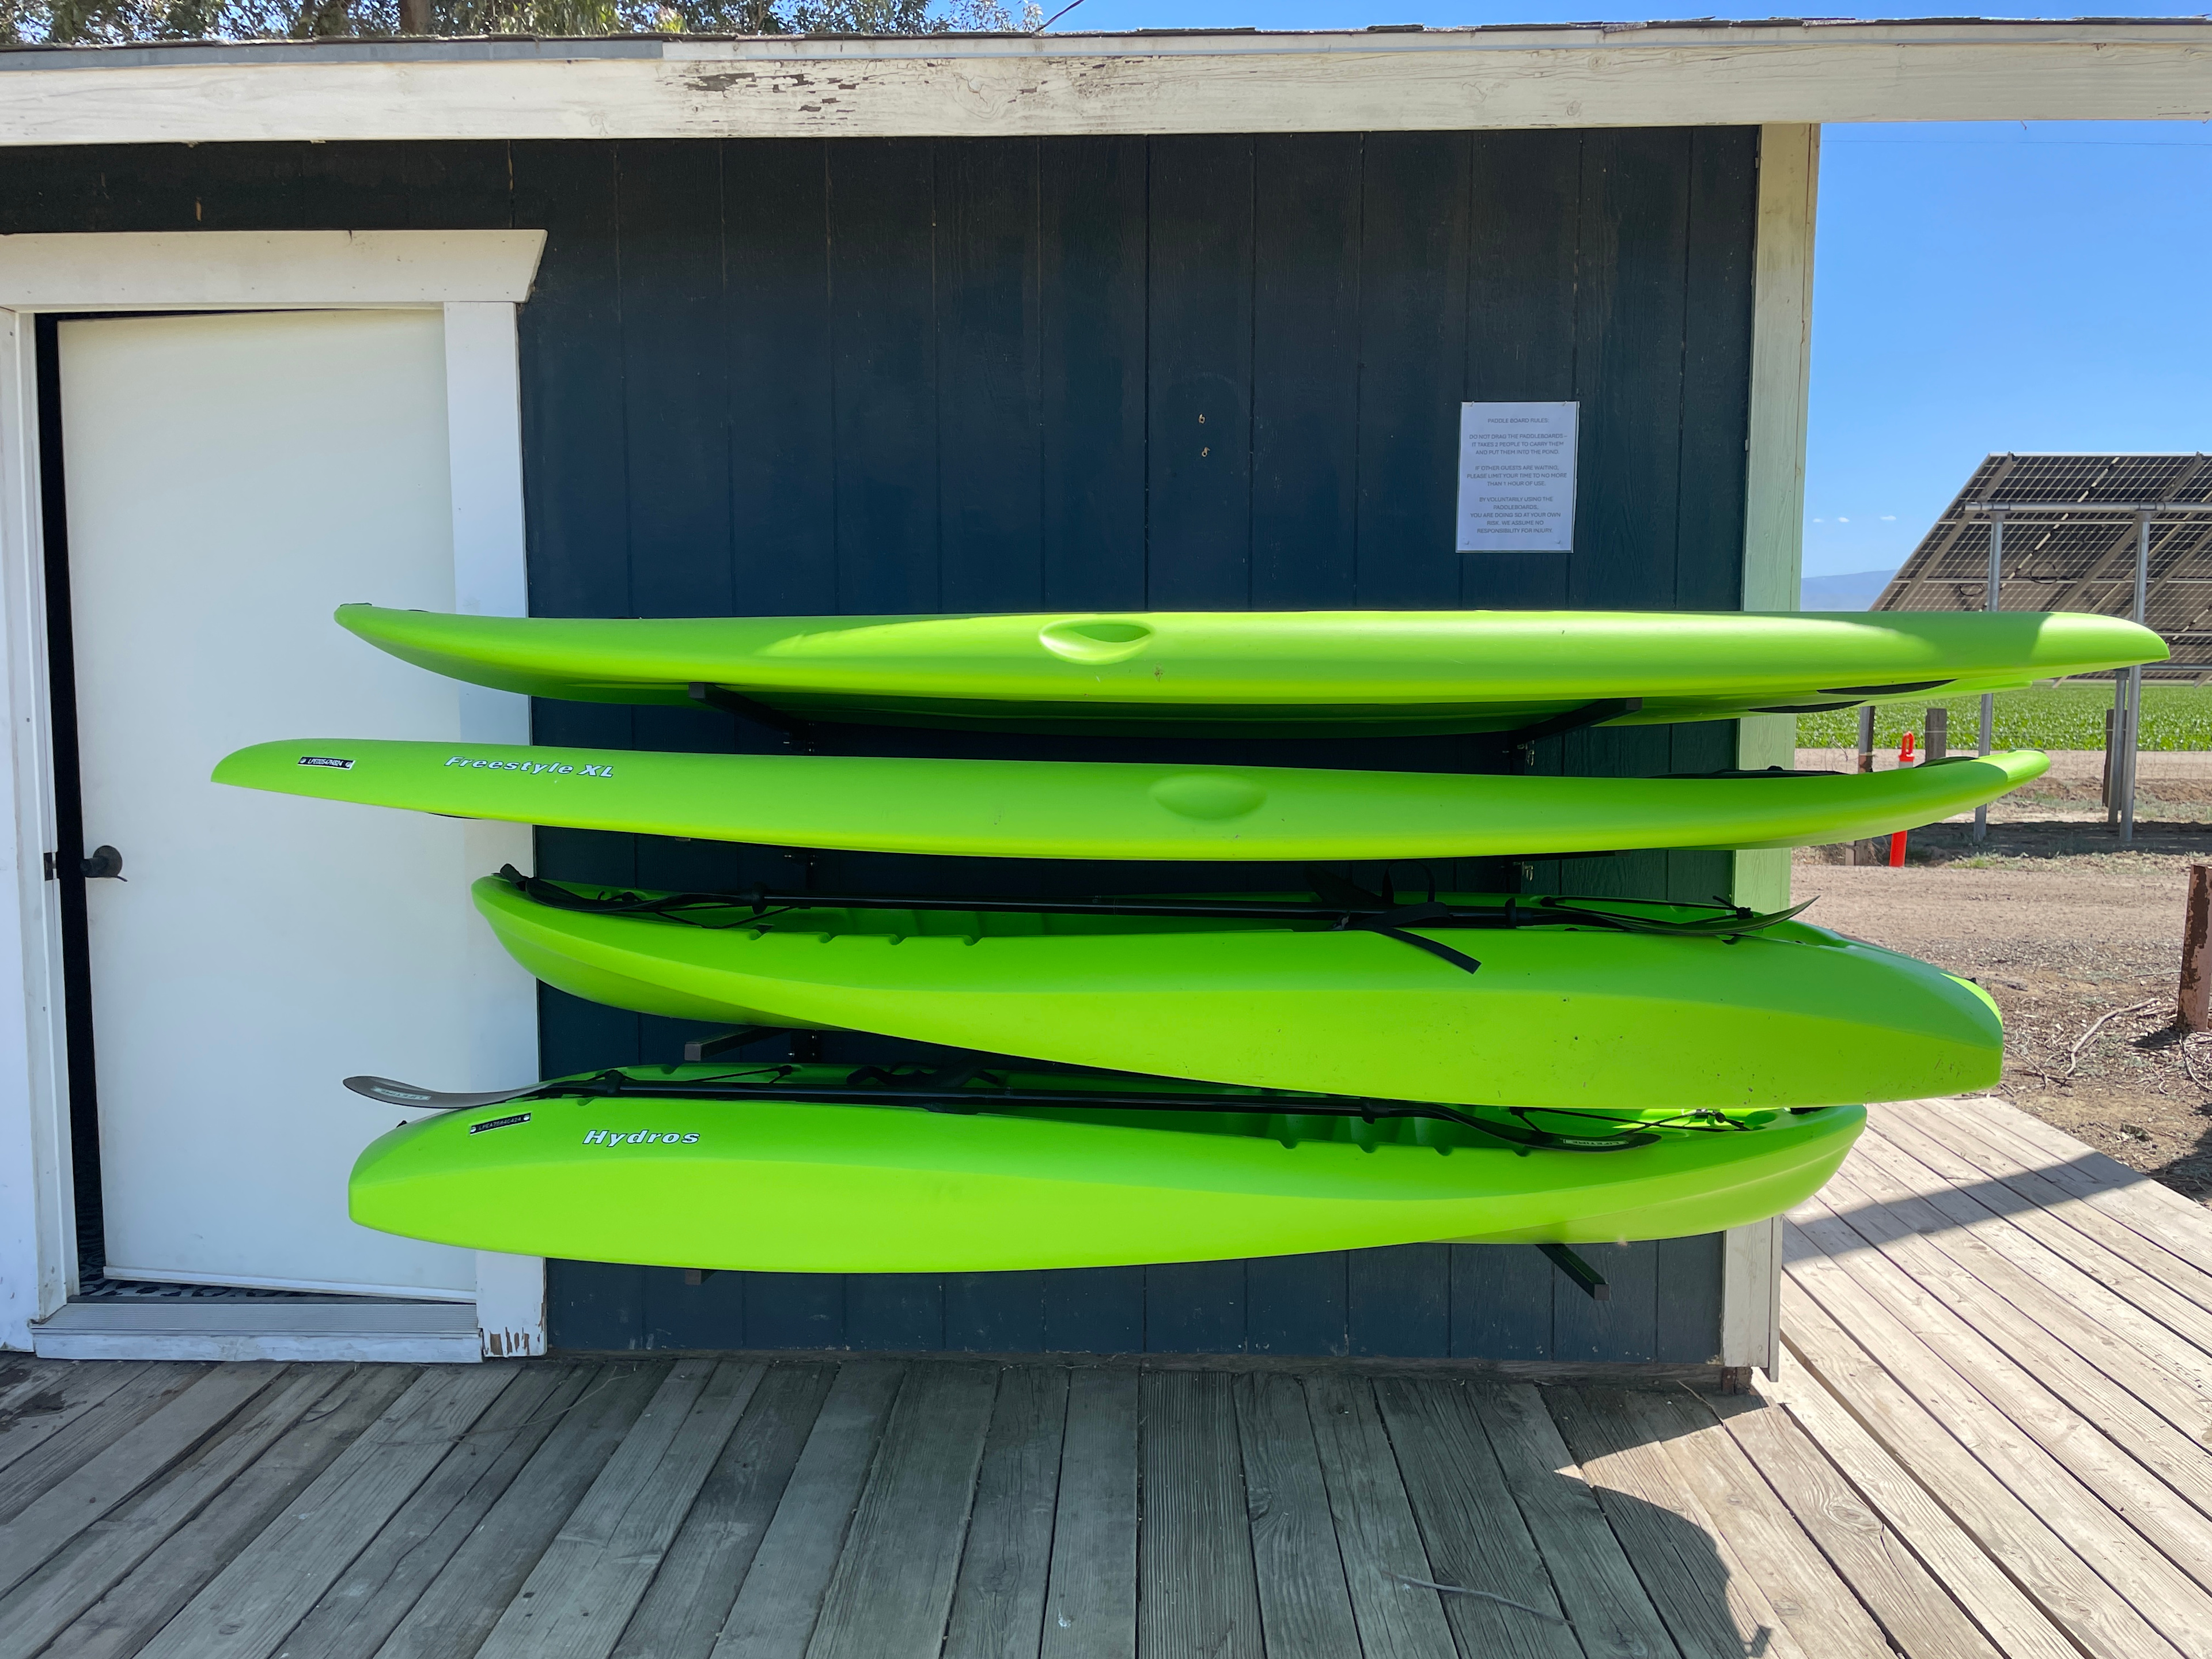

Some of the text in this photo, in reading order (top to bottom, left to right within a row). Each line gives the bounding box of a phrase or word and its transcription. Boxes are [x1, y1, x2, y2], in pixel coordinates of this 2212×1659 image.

[444, 756, 613, 778] Freestyle XL
[582, 1130, 700, 1147] Hydros
